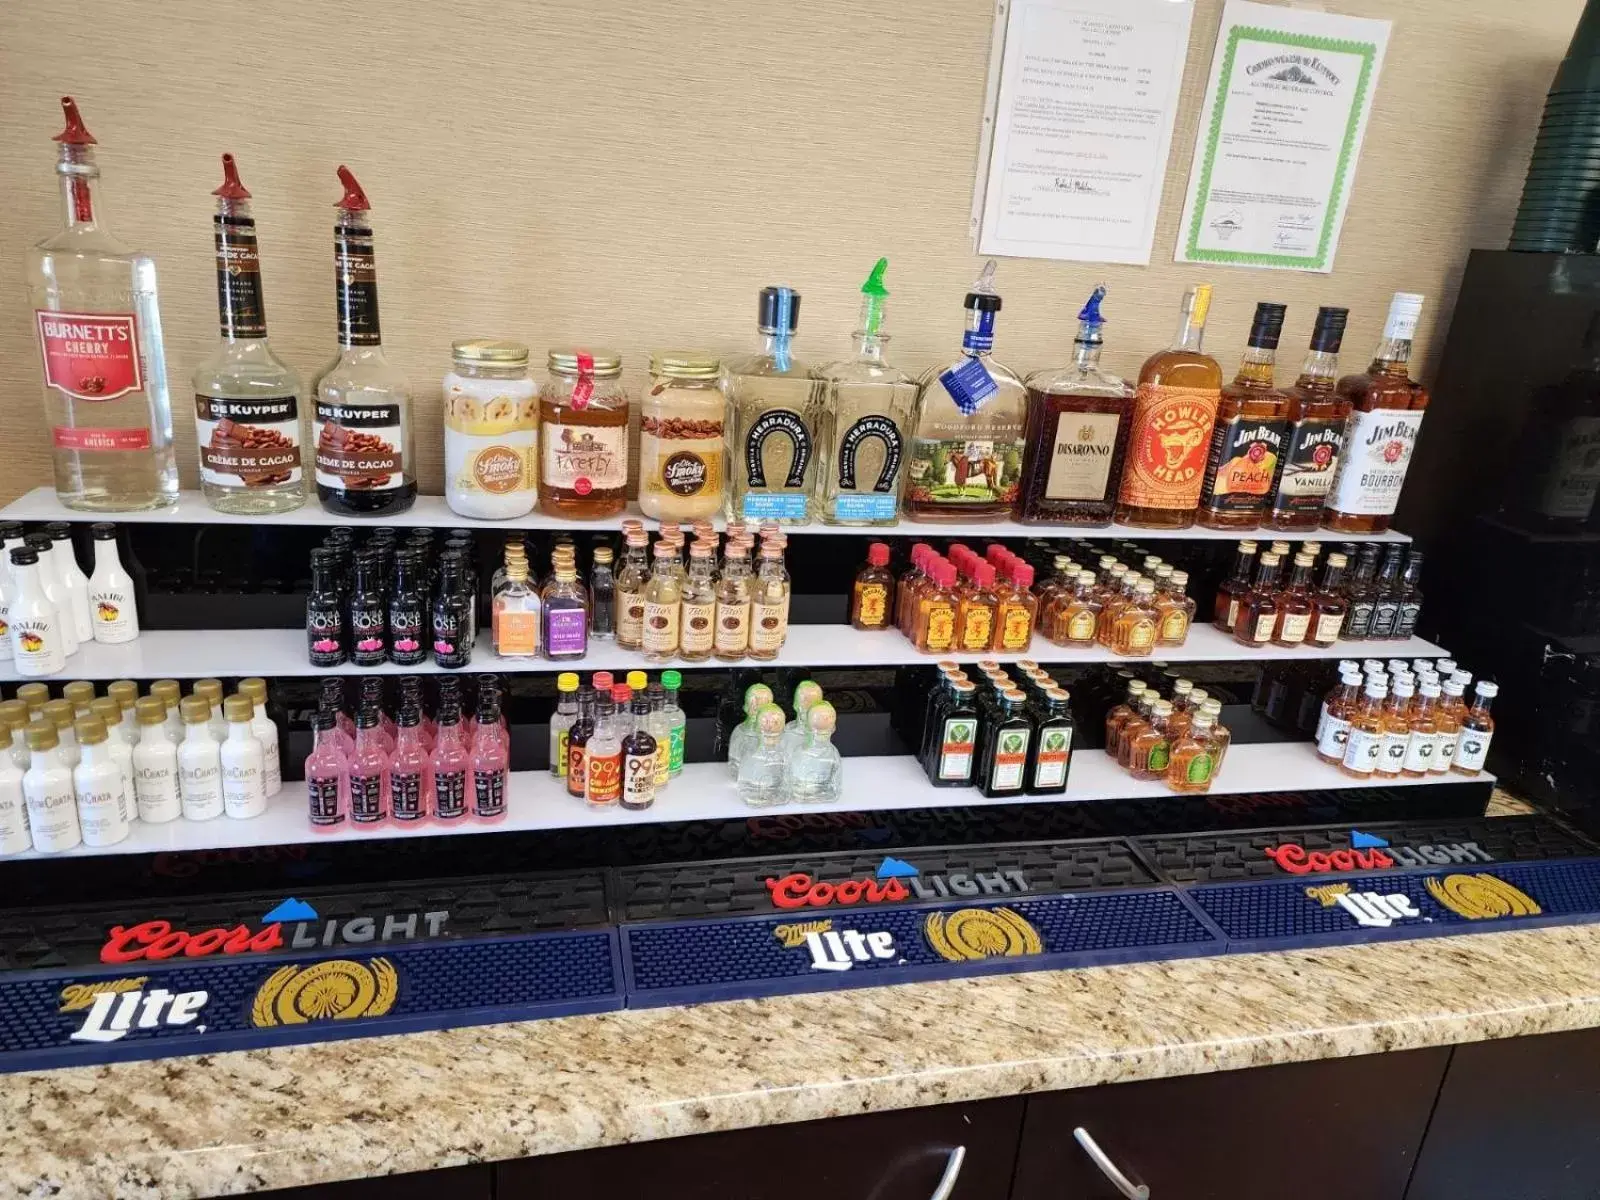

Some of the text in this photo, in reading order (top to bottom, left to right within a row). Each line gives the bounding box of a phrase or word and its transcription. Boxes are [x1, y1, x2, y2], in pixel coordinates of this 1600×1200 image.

[43, 321, 128, 341] BURNETT'S
[65, 341, 108, 354] CHERRY
[210, 404, 288, 415] DE KUYPER
[318, 406, 389, 419] DE KUYPER
[752, 416, 805, 442] HERRADURA
[1151, 407, 1212, 433] HOWLER
[848, 421, 899, 447] HERRADURA
[1234, 425, 1281, 448] JIM BEAM
[1300, 432, 1322, 450] JIM
[1366, 425, 1393, 445] JIM
[1057, 443, 1110, 456] DISARONNO
[241, 458, 256, 466] DE
[259, 454, 294, 466] CACAO
[342, 459, 355, 468] DE
[358, 460, 394, 469] CACAO
[1153, 464, 1196, 482] HEAD
[1232, 472, 1270, 482] PEACH
[308, 616, 341, 629] ROSE
[352, 616, 384, 629] ROSE
[390, 616, 422, 629] ROSE
[434, 617, 457, 631] OSE
[590, 761, 615, 779] 99
[630, 759, 653, 776] 99
[1265, 842, 1494, 874] Coors LIGHT
[766, 870, 1029, 908] Coors LIGHT
[1334, 891, 1420, 927] Lite
[100, 911, 449, 963] Coors LIGHT
[804, 929, 896, 971] Lite
[70, 990, 208, 1042] Lite
